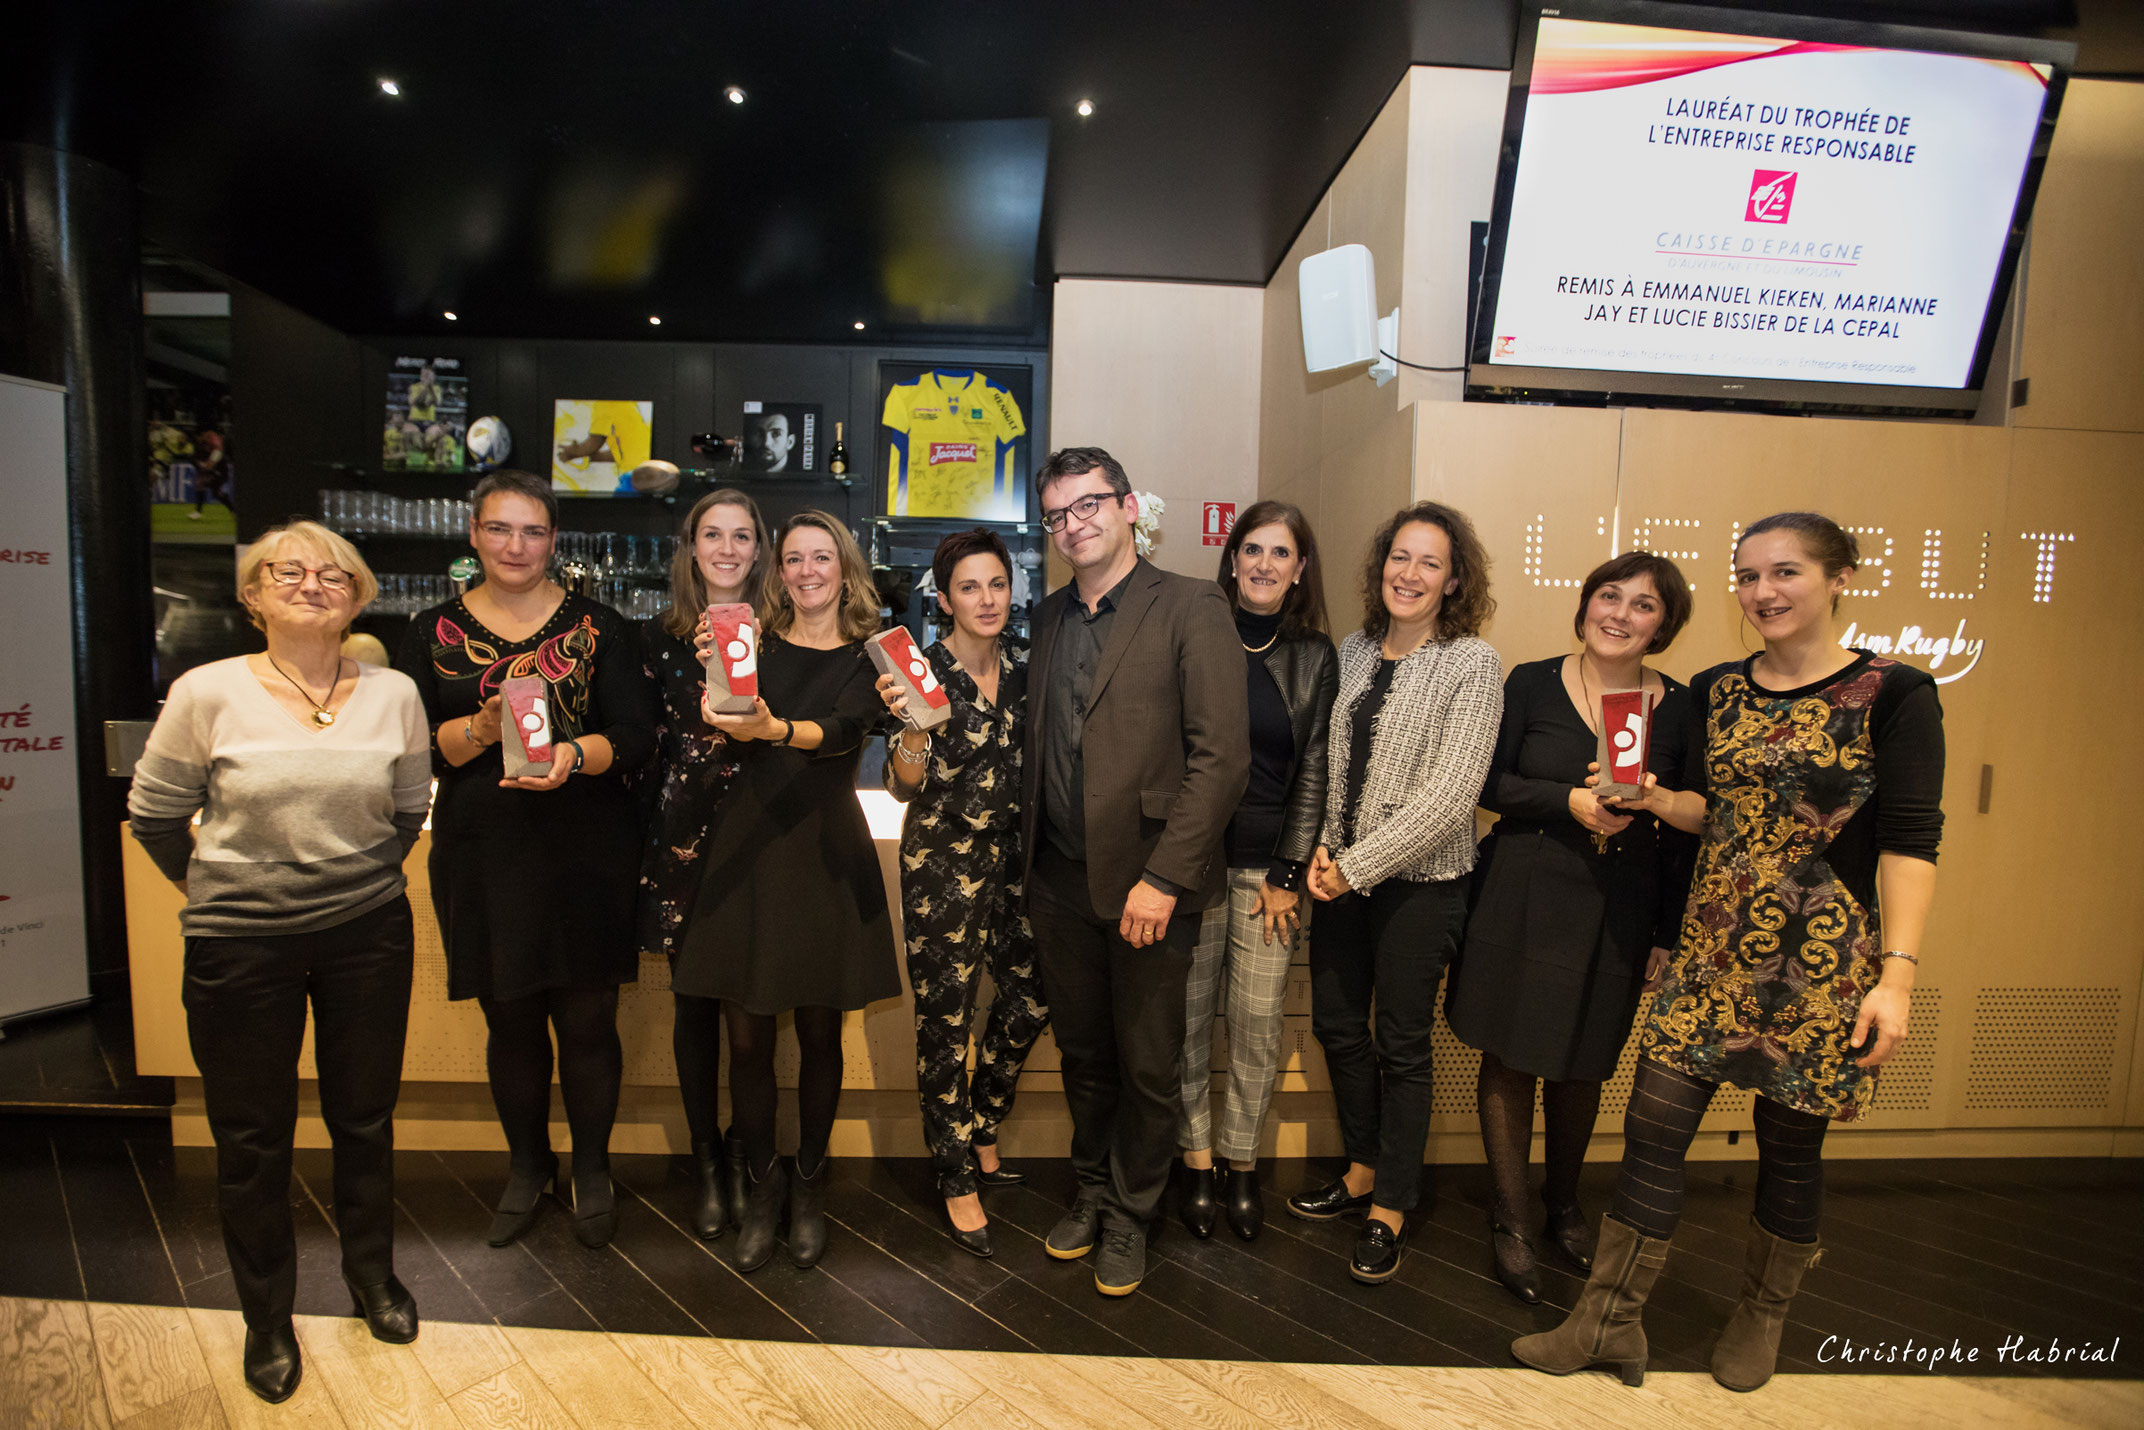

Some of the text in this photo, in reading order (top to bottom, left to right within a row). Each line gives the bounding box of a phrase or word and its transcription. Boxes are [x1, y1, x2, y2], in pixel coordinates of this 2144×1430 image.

[1666, 96, 1911, 136] LAURÉAT DU TROPHÉE DE
[1649, 124, 1917, 164] L'ENTREPRISE RESPONSABLE
[1656, 232, 1732, 251] CAISSE
[1557, 274, 1939, 316] REMIS À EMMANUEL KIEKEN, MARIANNE
[1584, 304, 1901, 339] JAY ET LUCIE BISSIER DE LA CEPAL
[993, 392, 1018, 430] RENAULT
[930, 445, 977, 463] Jacquet
[1894, 618, 1985, 684] Rugby
